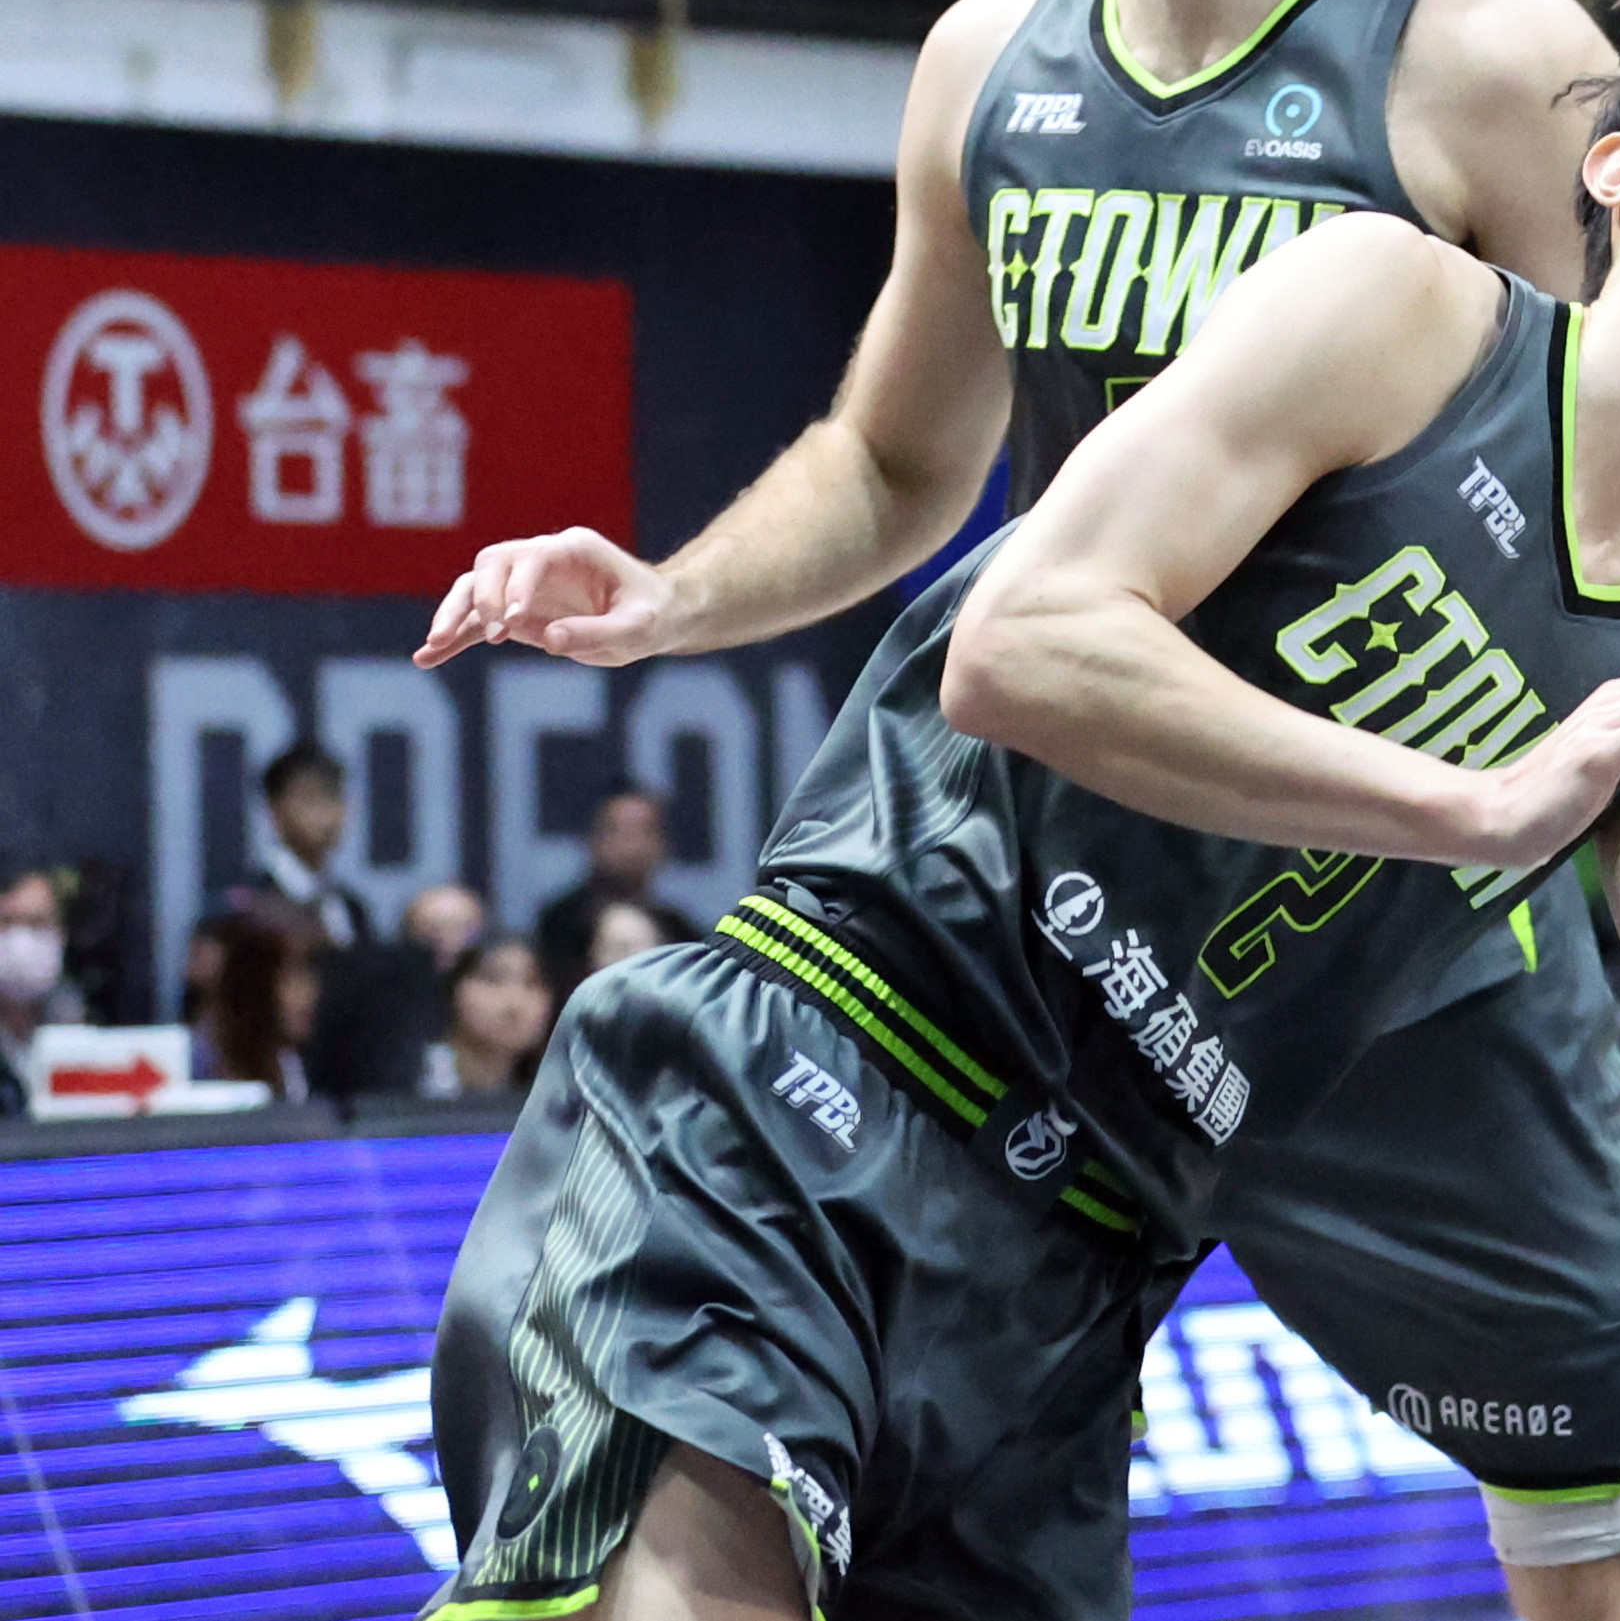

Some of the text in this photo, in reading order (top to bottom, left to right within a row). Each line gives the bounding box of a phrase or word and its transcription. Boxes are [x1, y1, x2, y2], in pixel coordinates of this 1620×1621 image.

[1004, 92, 1088, 135] TPBL
[1244, 138, 1323, 161] EVOASIS
[236, 334, 472, 530] 台畜
[1456, 455, 1527, 559] TPBL
[1082, 928, 1251, 1147] 海碩集團
[769, 1049, 862, 1154] TPBL
